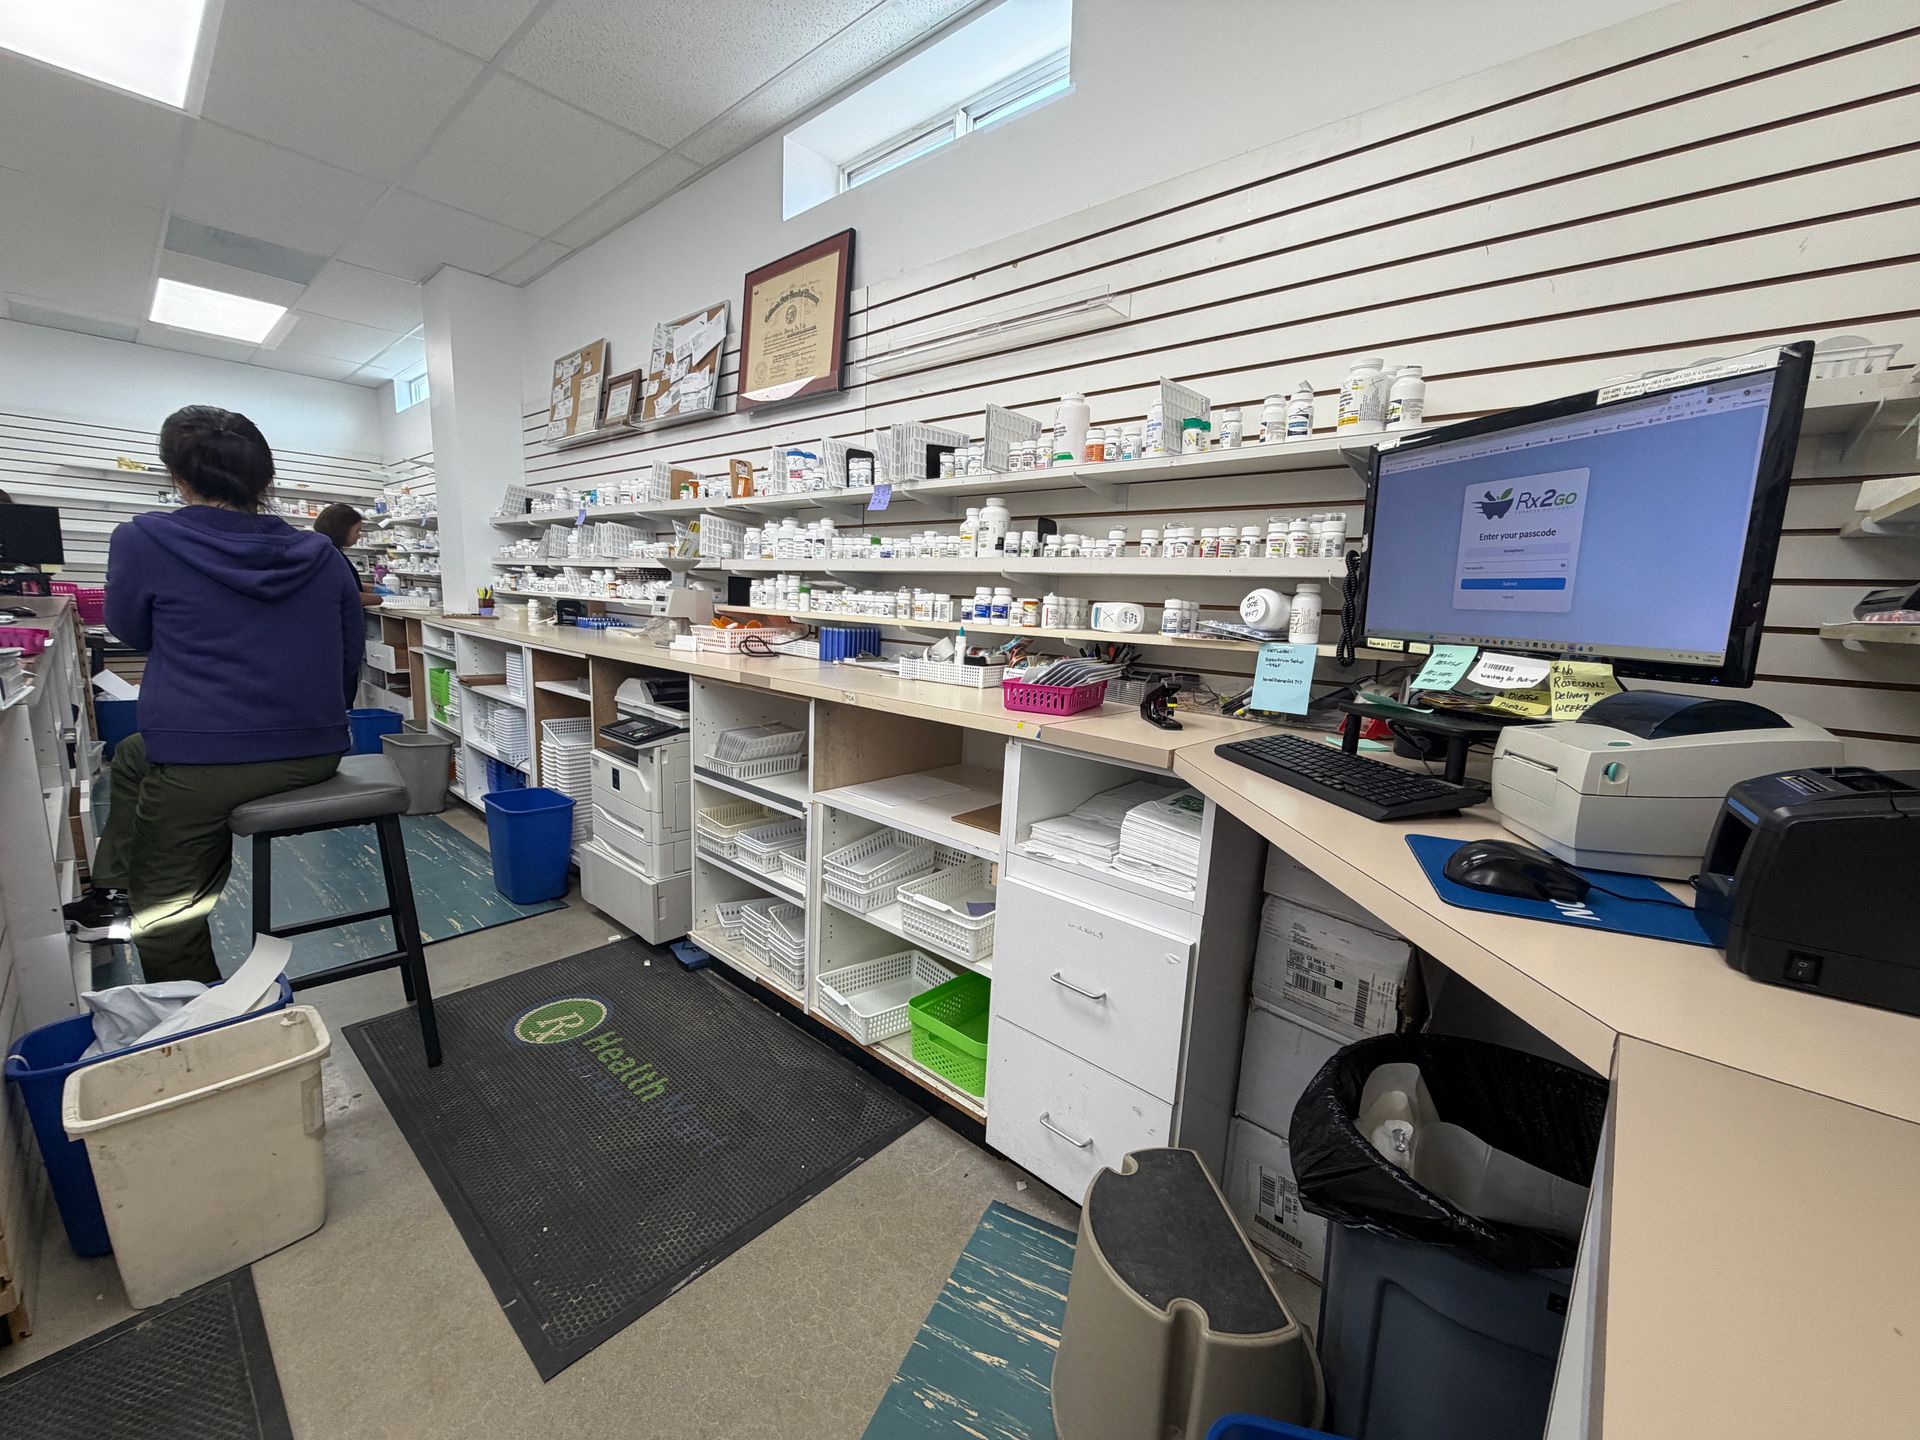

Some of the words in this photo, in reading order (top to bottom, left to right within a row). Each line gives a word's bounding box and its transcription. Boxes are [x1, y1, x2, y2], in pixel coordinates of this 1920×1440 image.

[1479, 532, 1499, 541] Enter
[1500, 532, 1518, 541] your
[1519, 528, 1557, 541] passcode
[1562, 664, 1574, 676] No
[1554, 691, 1590, 702] Delivery
[1555, 704, 1592, 712] WEEKE
[582, 1031, 669, 1103] Health
